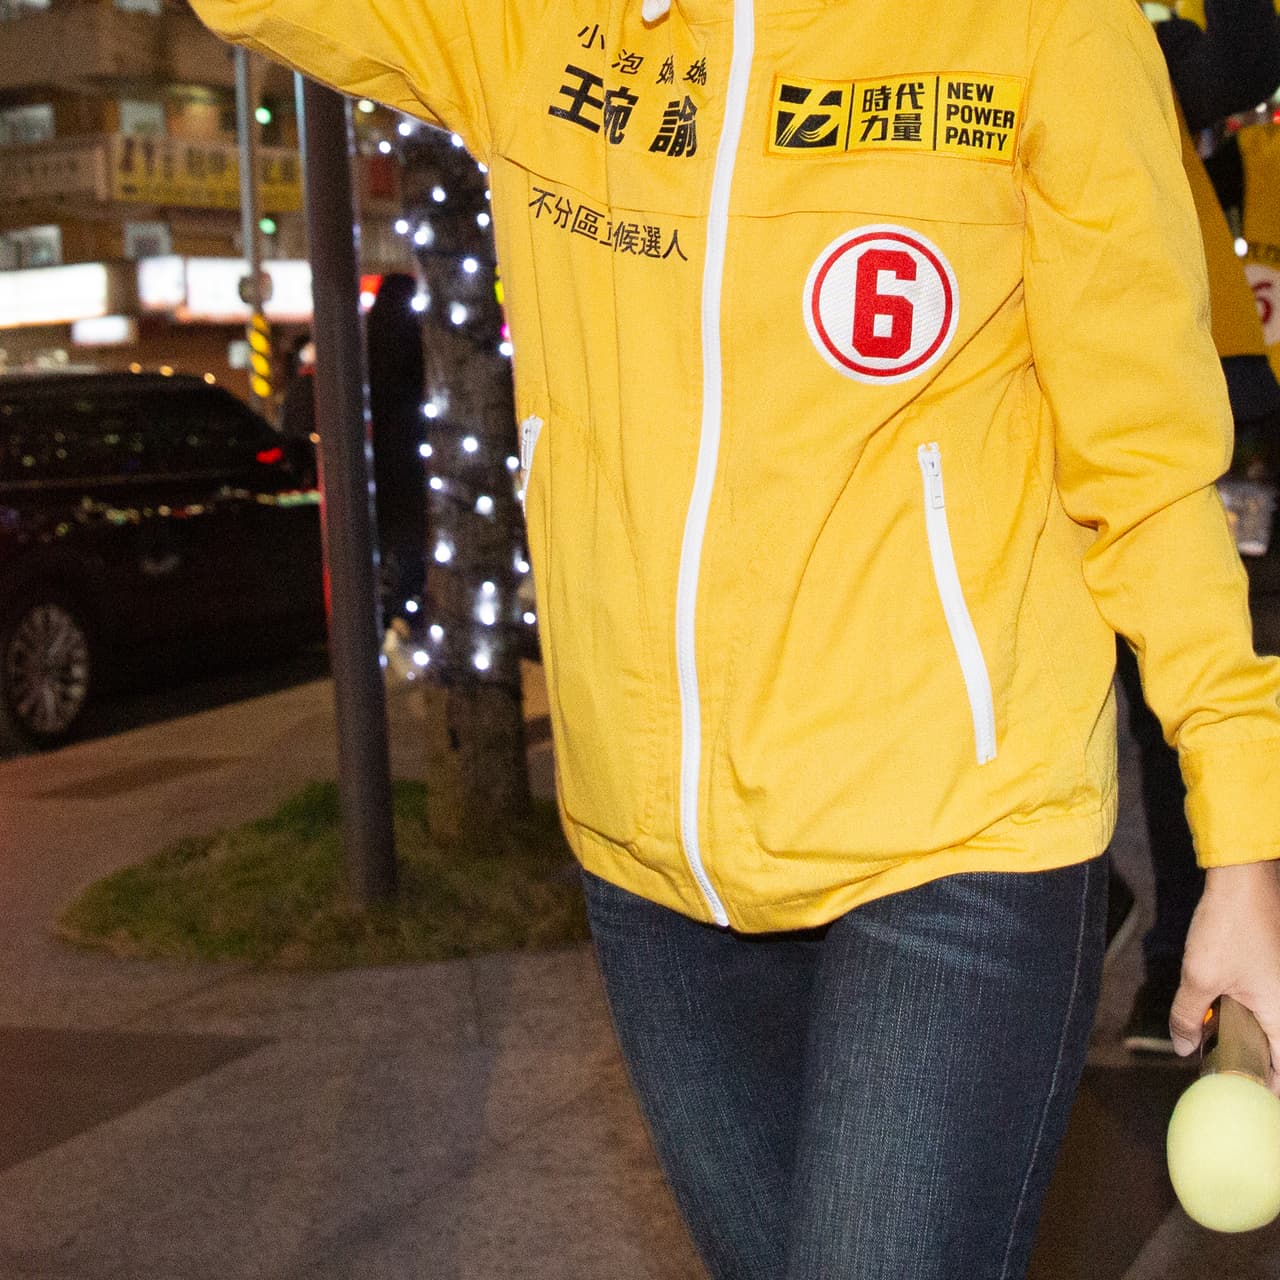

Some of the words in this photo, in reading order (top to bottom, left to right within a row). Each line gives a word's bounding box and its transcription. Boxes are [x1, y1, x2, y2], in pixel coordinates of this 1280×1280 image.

[861, 81, 925, 112] 時代
[947, 81, 995, 102] NEW
[859, 111, 924, 143] 力量
[946, 104, 1016, 130] POWER
[945, 126, 1010, 152] PARTY
[852, 248, 918, 359] 6
